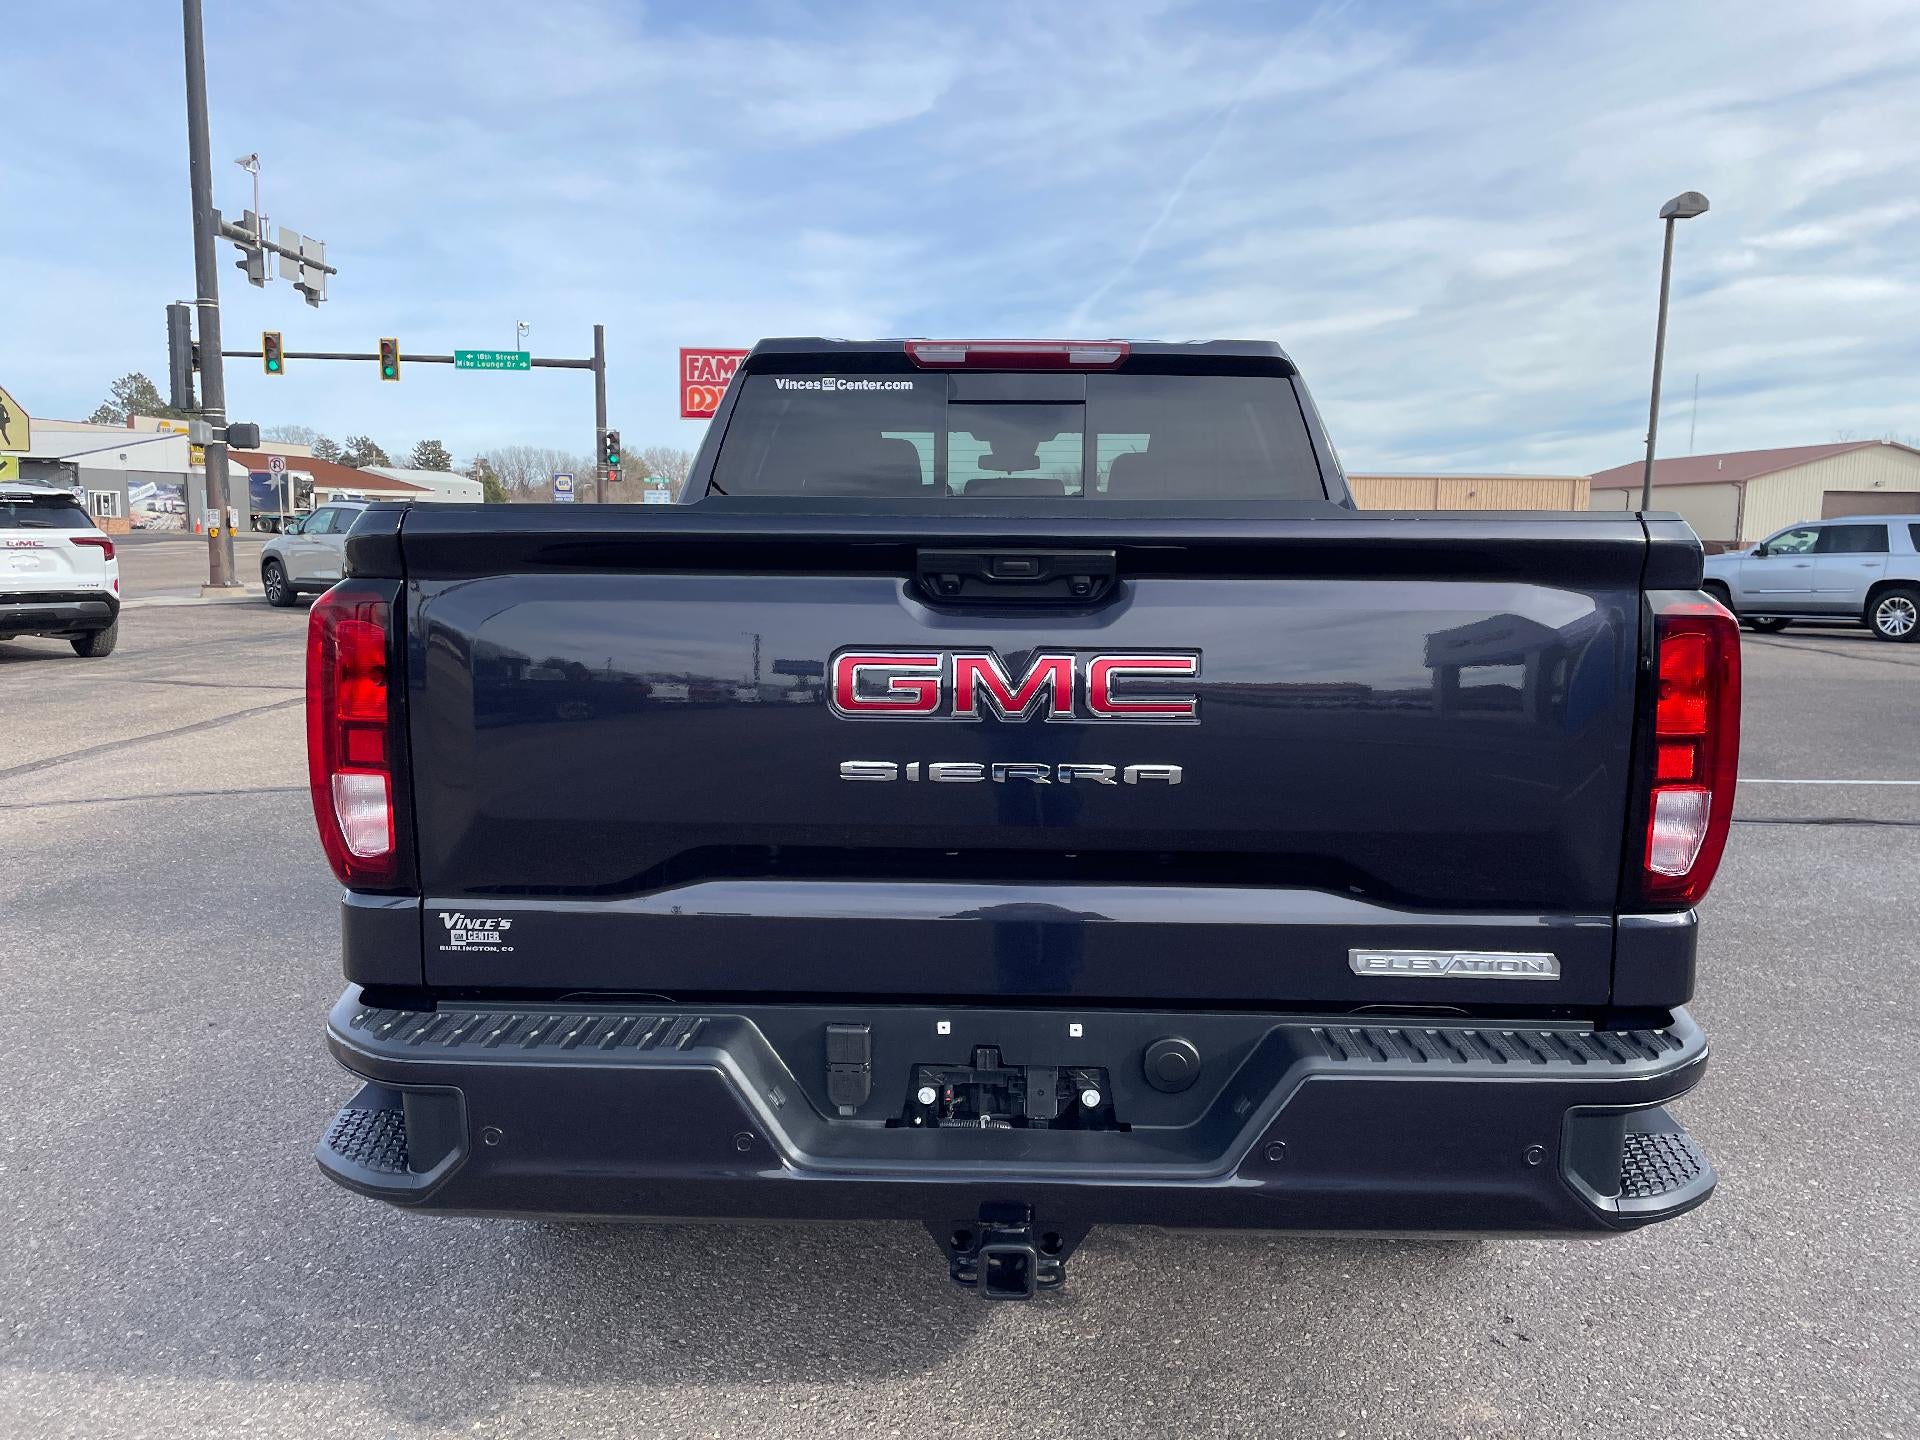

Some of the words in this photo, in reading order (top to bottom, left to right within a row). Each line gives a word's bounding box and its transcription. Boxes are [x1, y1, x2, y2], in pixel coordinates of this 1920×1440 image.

[687, 355, 745, 382] FAM
[775, 378, 821, 390] Vinces
[837, 379, 914, 390] Center.com
[832, 652, 1198, 720] GMC
[839, 760, 1183, 786] SIERRA
[467, 931, 500, 941] CENTER
[1365, 957, 1545, 972] ELEVATION
